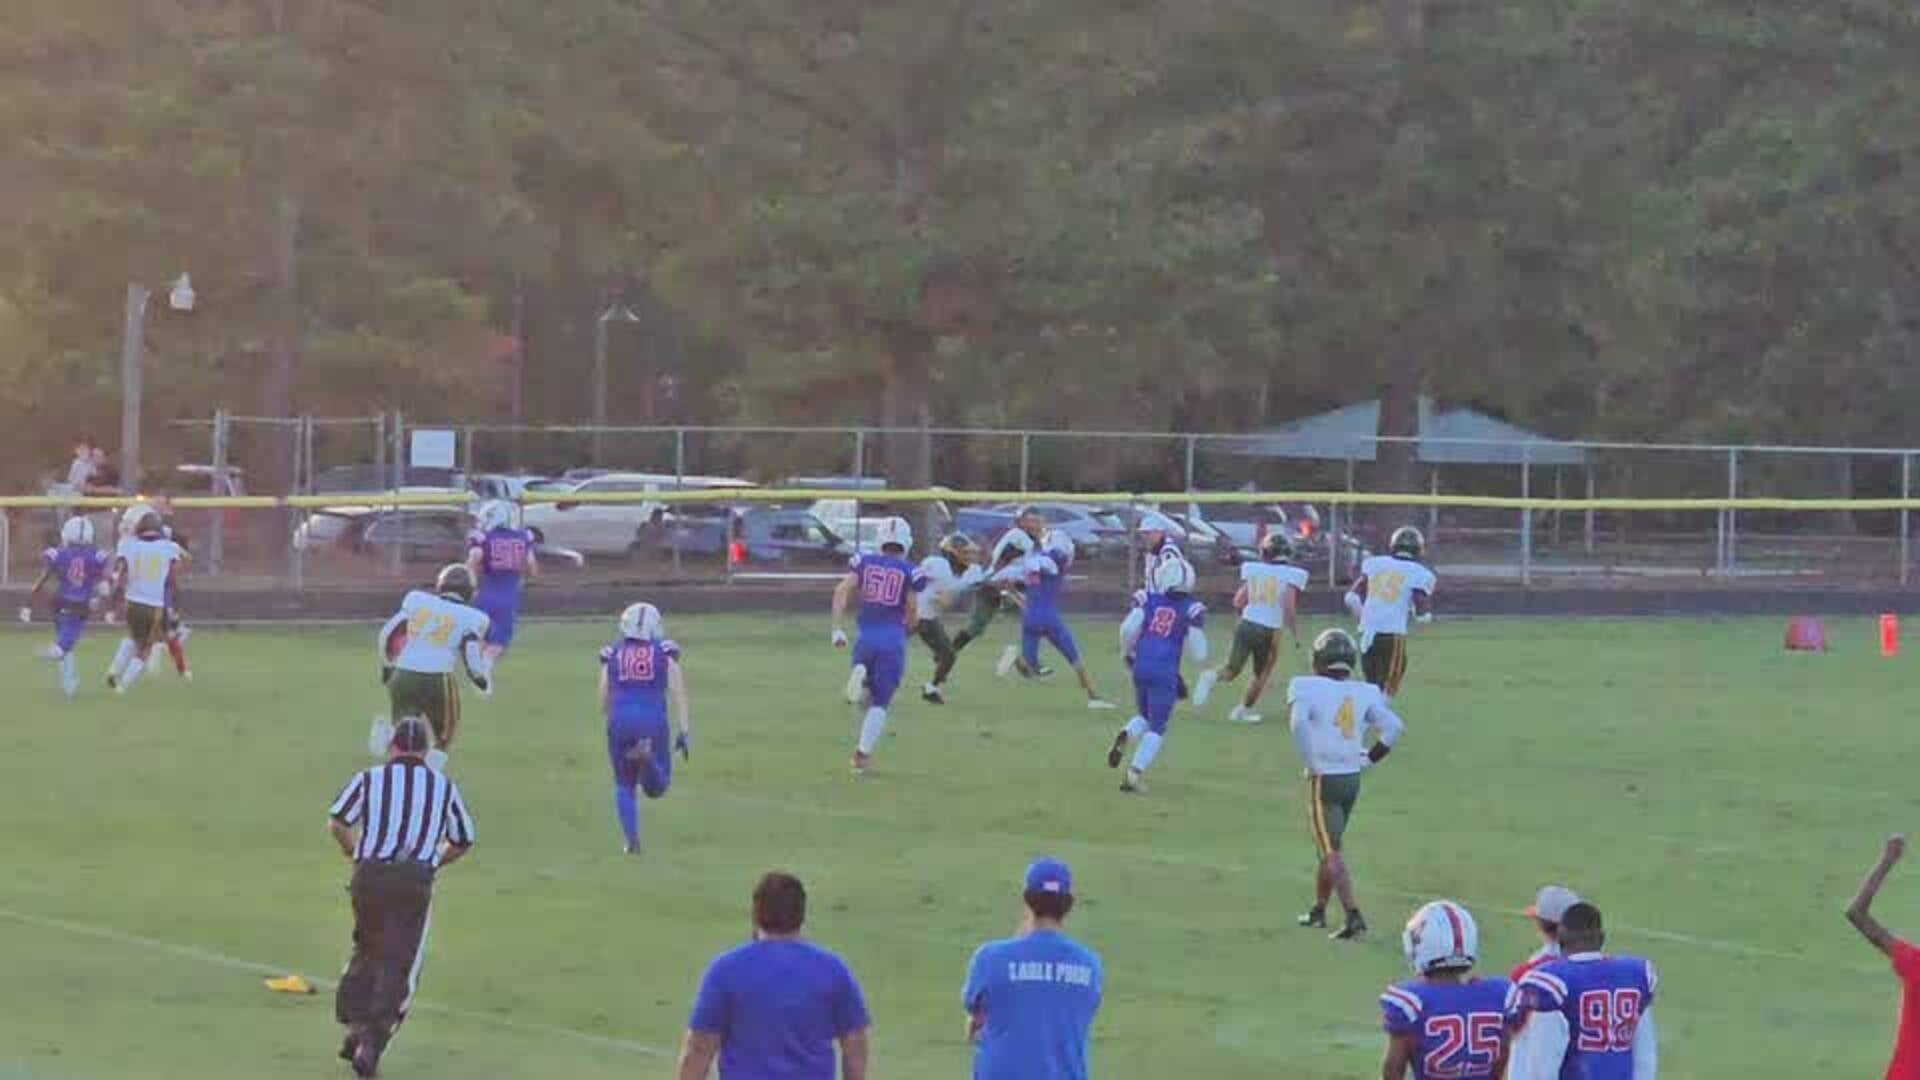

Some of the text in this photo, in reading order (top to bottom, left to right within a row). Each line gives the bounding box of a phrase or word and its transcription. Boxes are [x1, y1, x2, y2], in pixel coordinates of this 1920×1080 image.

[69, 556, 85, 587] 4
[617, 644, 655, 681] 18
[1333, 695, 1356, 740] 4
[1577, 988, 1640, 1053] 98
[1422, 1011, 1503, 1077] 25
